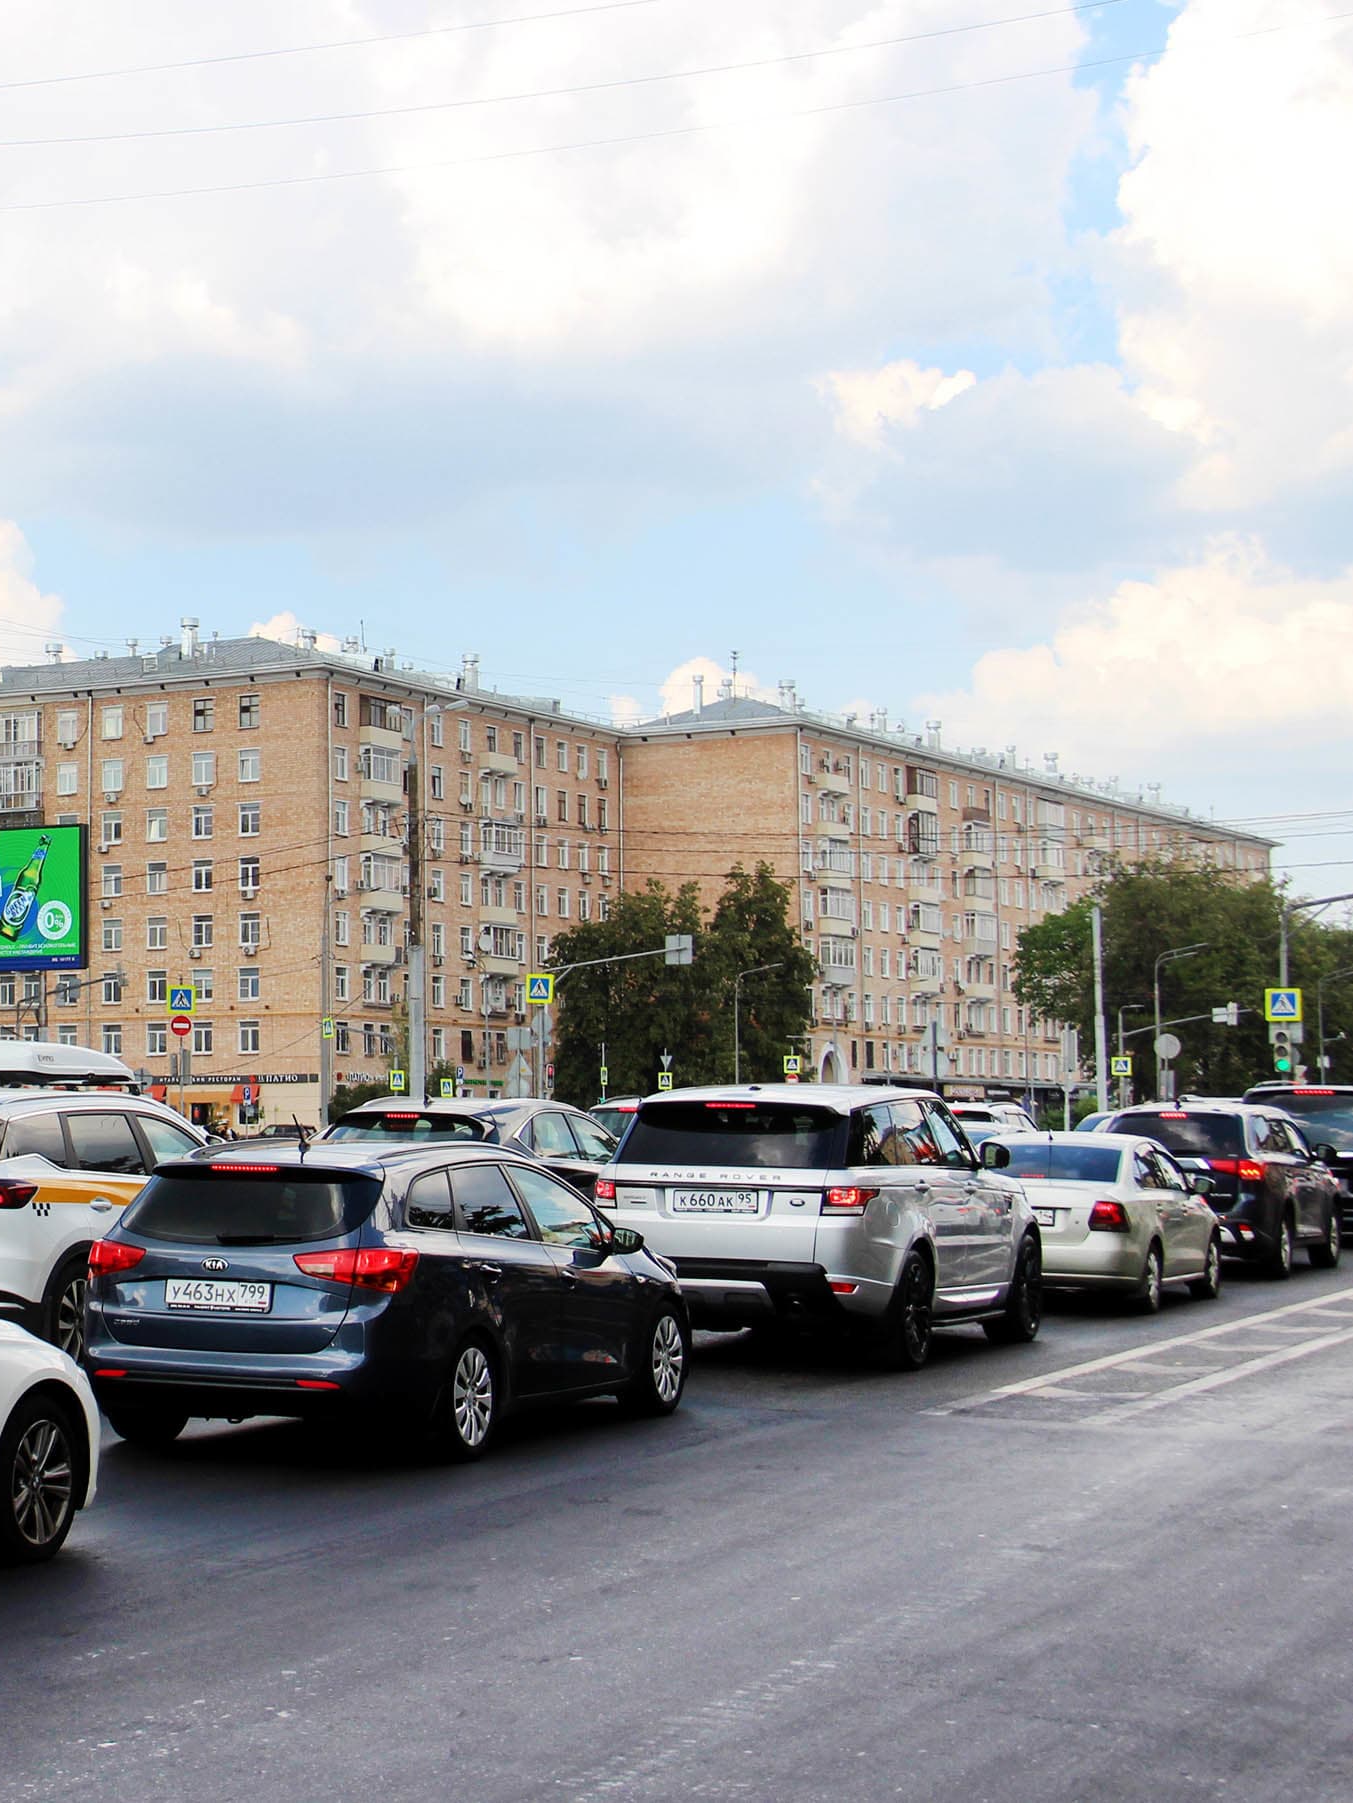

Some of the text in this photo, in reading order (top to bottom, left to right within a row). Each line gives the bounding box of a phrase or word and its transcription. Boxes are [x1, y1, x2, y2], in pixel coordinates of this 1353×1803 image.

[208, 1075, 241, 1083] РЕСТОРАН
[266, 1073, 299, 1083] ПАТИО
[650, 1171, 781, 1181] RANGE ROVER
[738, 1193, 752, 1204] 95
[205, 1260, 224, 1270] KIA
[240, 1284, 265, 1299] 799
